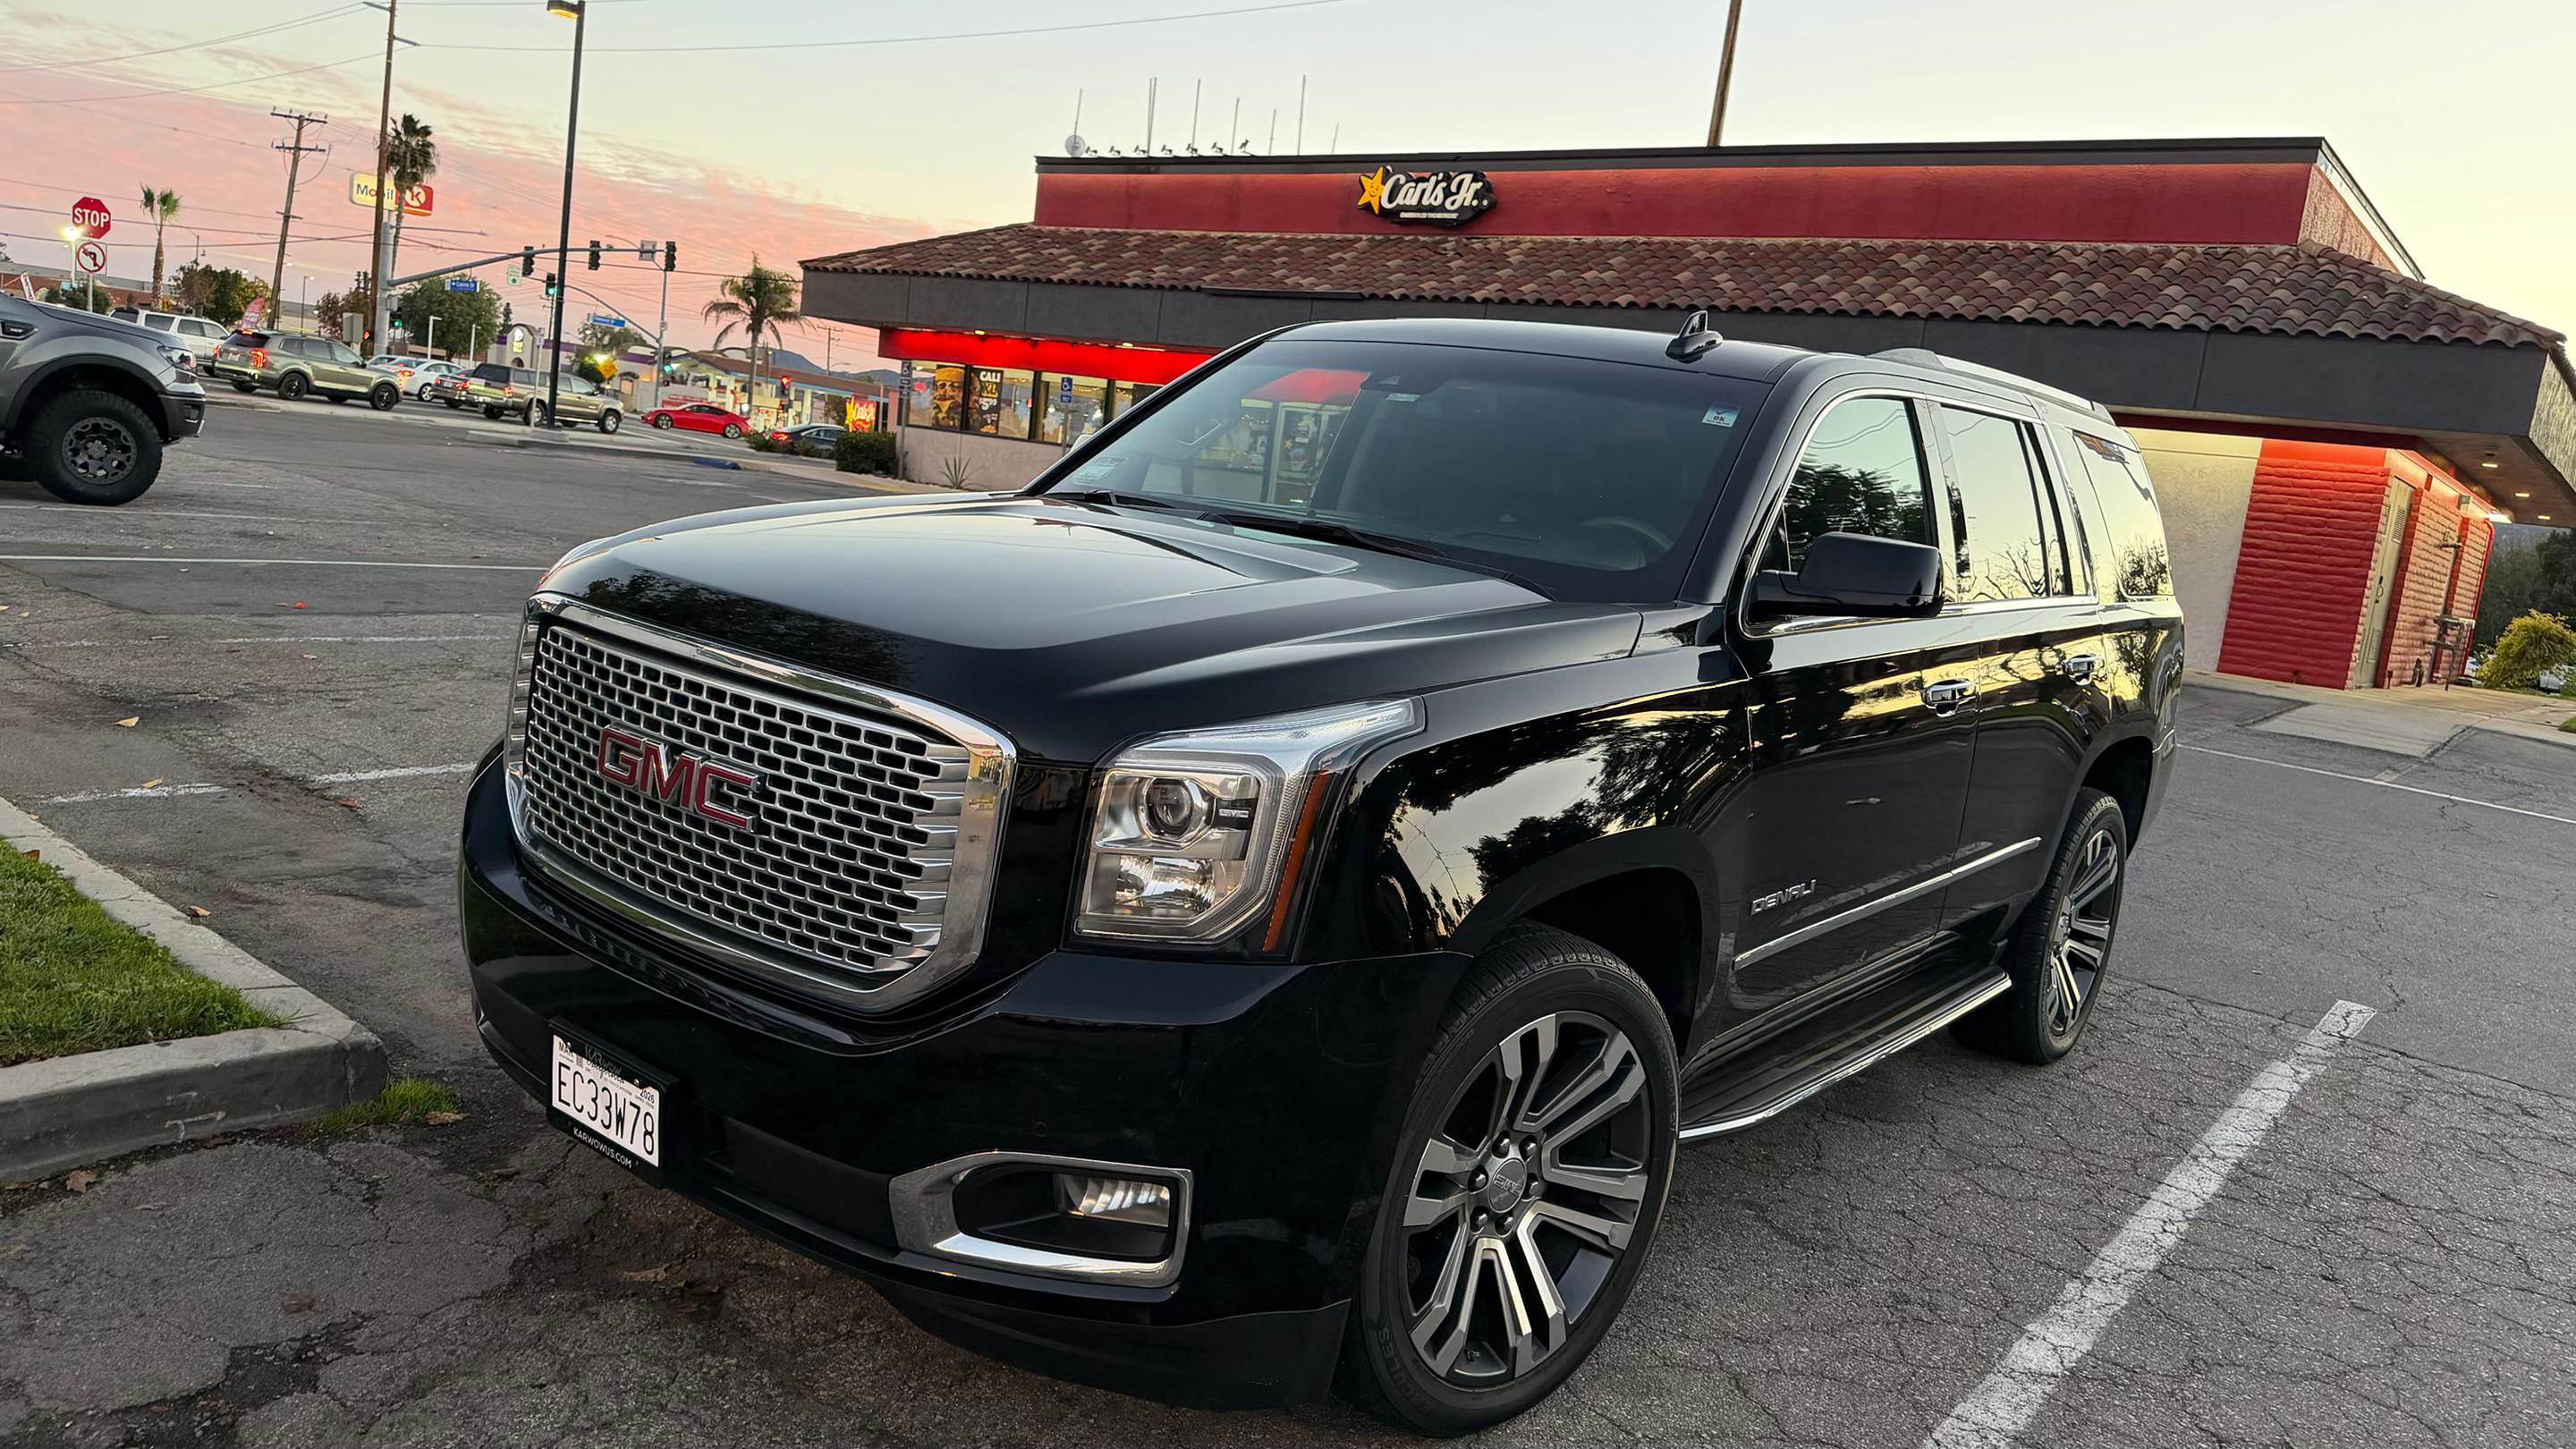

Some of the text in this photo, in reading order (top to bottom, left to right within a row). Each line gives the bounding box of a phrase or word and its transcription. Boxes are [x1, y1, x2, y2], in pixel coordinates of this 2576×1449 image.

[356, 183, 394, 200] Moil
[1380, 172, 1479, 211] Carl's Jr.
[73, 207, 109, 228] STOP
[979, 370, 1001, 383] CALI
[597, 724, 759, 834] GMC
[1218, 808, 1249, 818] GMC
[1750, 878, 1817, 916] DENALI
[558, 1061, 655, 1156] EC33W78
[573, 1126, 632, 1169] KARWOWUS.COM
